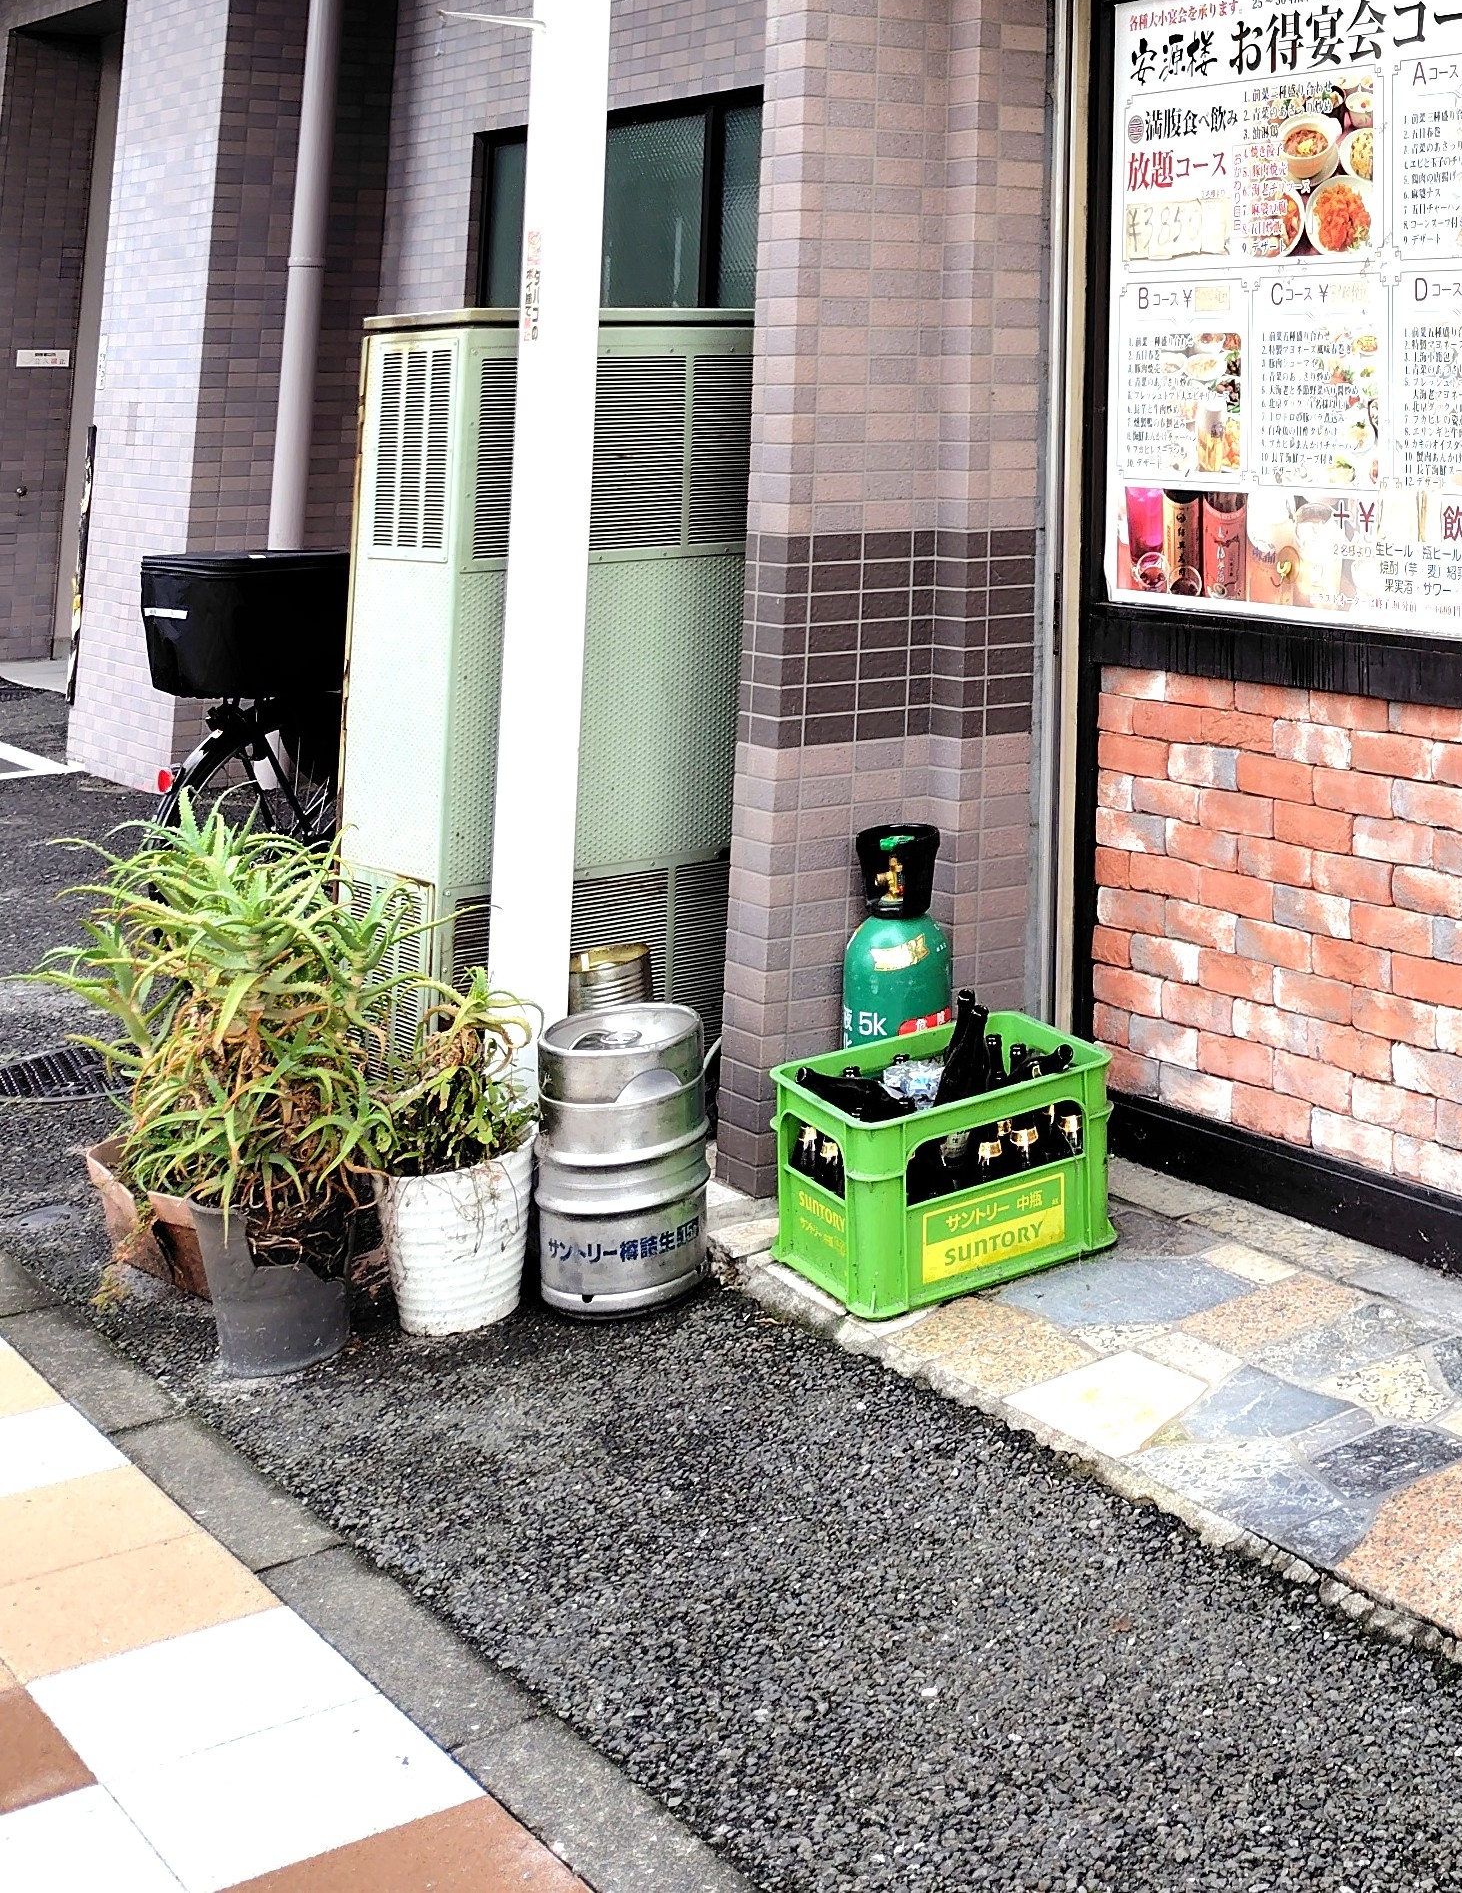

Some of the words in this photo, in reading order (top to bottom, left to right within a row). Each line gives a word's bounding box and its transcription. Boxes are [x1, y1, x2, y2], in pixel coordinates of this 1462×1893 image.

[1145, 106, 1238, 142] 満腹食べ飲み
[1127, 149, 1227, 192] 放題コース
[798, 1190, 846, 1234] SUNTORY
[944, 1202, 1010, 1233] サントリー
[1016, 1189, 1043, 1212] 中瓶
[944, 1220, 1045, 1267] SUNTORY
